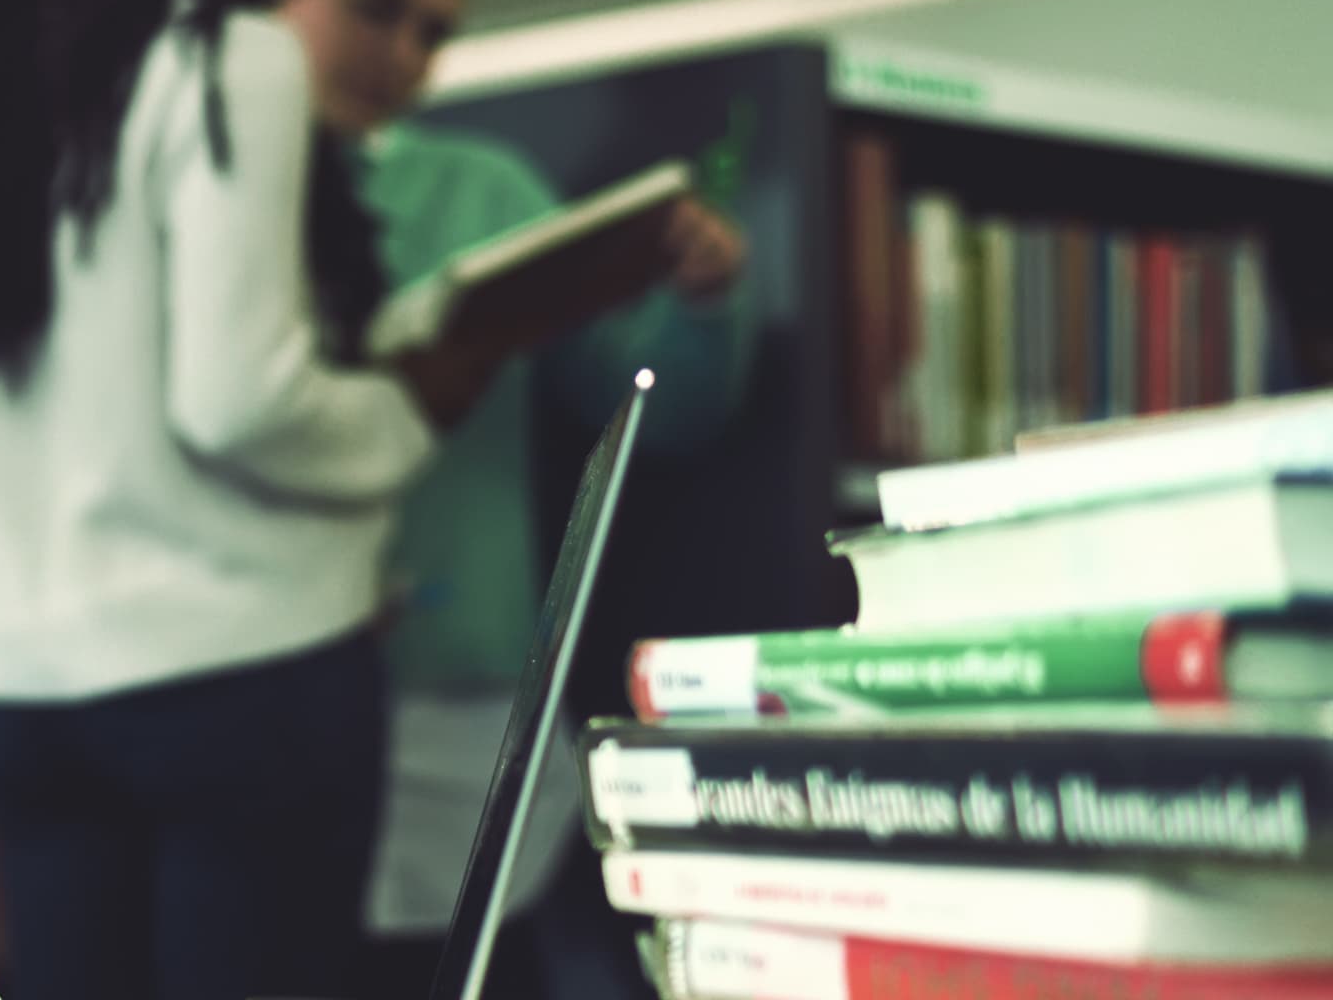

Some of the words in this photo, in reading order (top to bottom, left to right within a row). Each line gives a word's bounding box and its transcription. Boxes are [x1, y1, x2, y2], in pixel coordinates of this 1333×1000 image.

[694, 767, 807, 830] randes
[805, 767, 957, 842] Enigmas
[960, 771, 1007, 838] de
[1010, 773, 1055, 842] la
[1057, 771, 1306, 858] Humanidad
